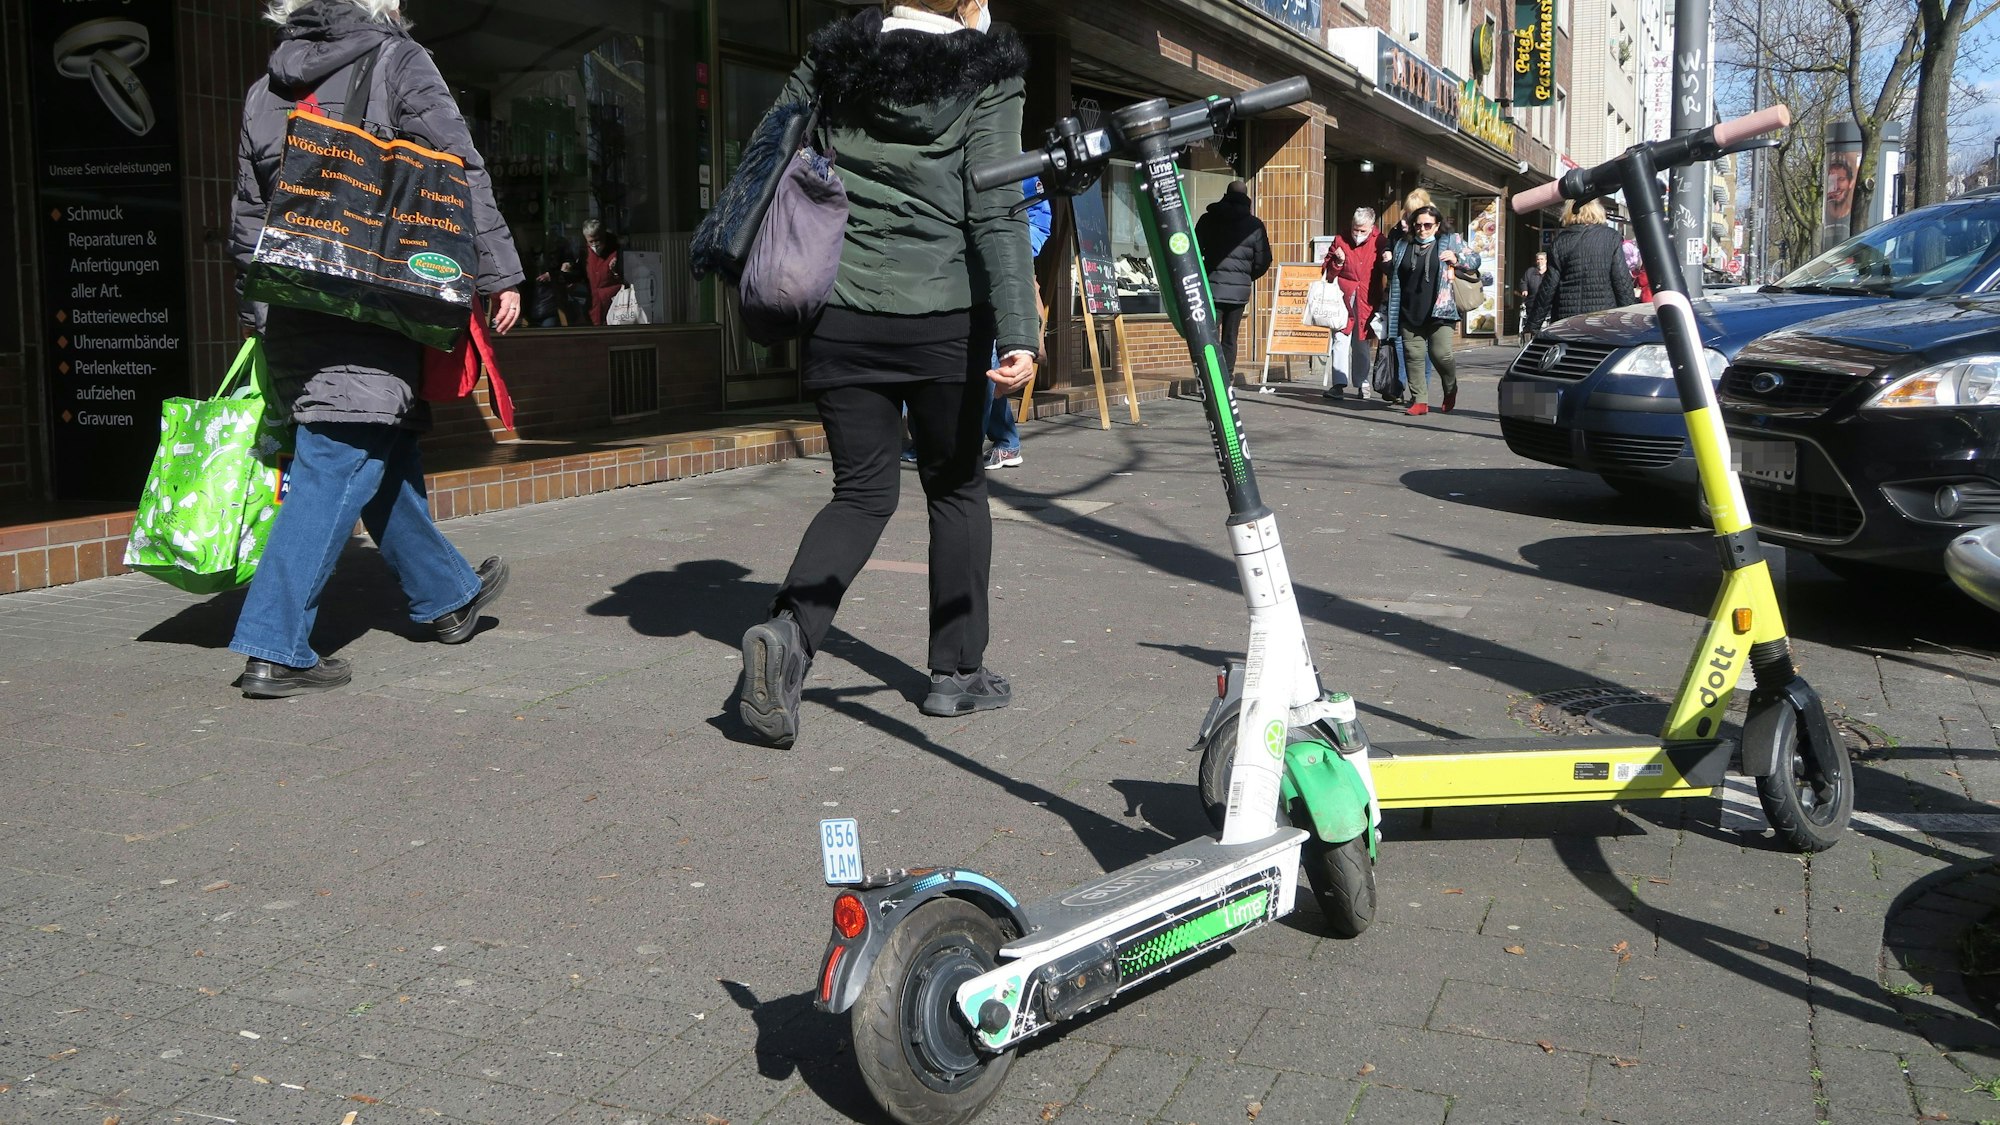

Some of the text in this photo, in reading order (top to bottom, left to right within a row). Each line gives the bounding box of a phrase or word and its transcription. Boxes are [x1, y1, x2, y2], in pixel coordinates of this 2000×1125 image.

[1514, 24, 1535, 74] Petek
[49, 161, 172, 177] Unsere Serviceleistungen
[1149, 162, 1172, 175] Lime
[279, 180, 331, 198] Delikatess
[321, 169, 382, 196] Knasspralin
[67, 205, 123, 221] Schmuck
[391, 206, 461, 234] Leckerche
[68, 230, 157, 250] Reparaturen &
[70, 257, 159, 276] Anfertigungen
[414, 259, 456, 274] Remagen
[71, 283, 122, 298] aller Art.
[1182, 273, 1206, 322] Lime
[72, 308, 169, 324] Batteriewechsel
[73, 334, 179, 350] Uhrenarmbänder
[75, 360, 157, 375] Perlenketten-
[76, 386, 136, 401] aufziehen
[78, 410, 133, 426] Gravuren
[1699, 645, 1736, 708] dott
[825, 824, 854, 848] 856
[829, 854, 858, 878] IAM
[1224, 898, 1264, 929] Lime
